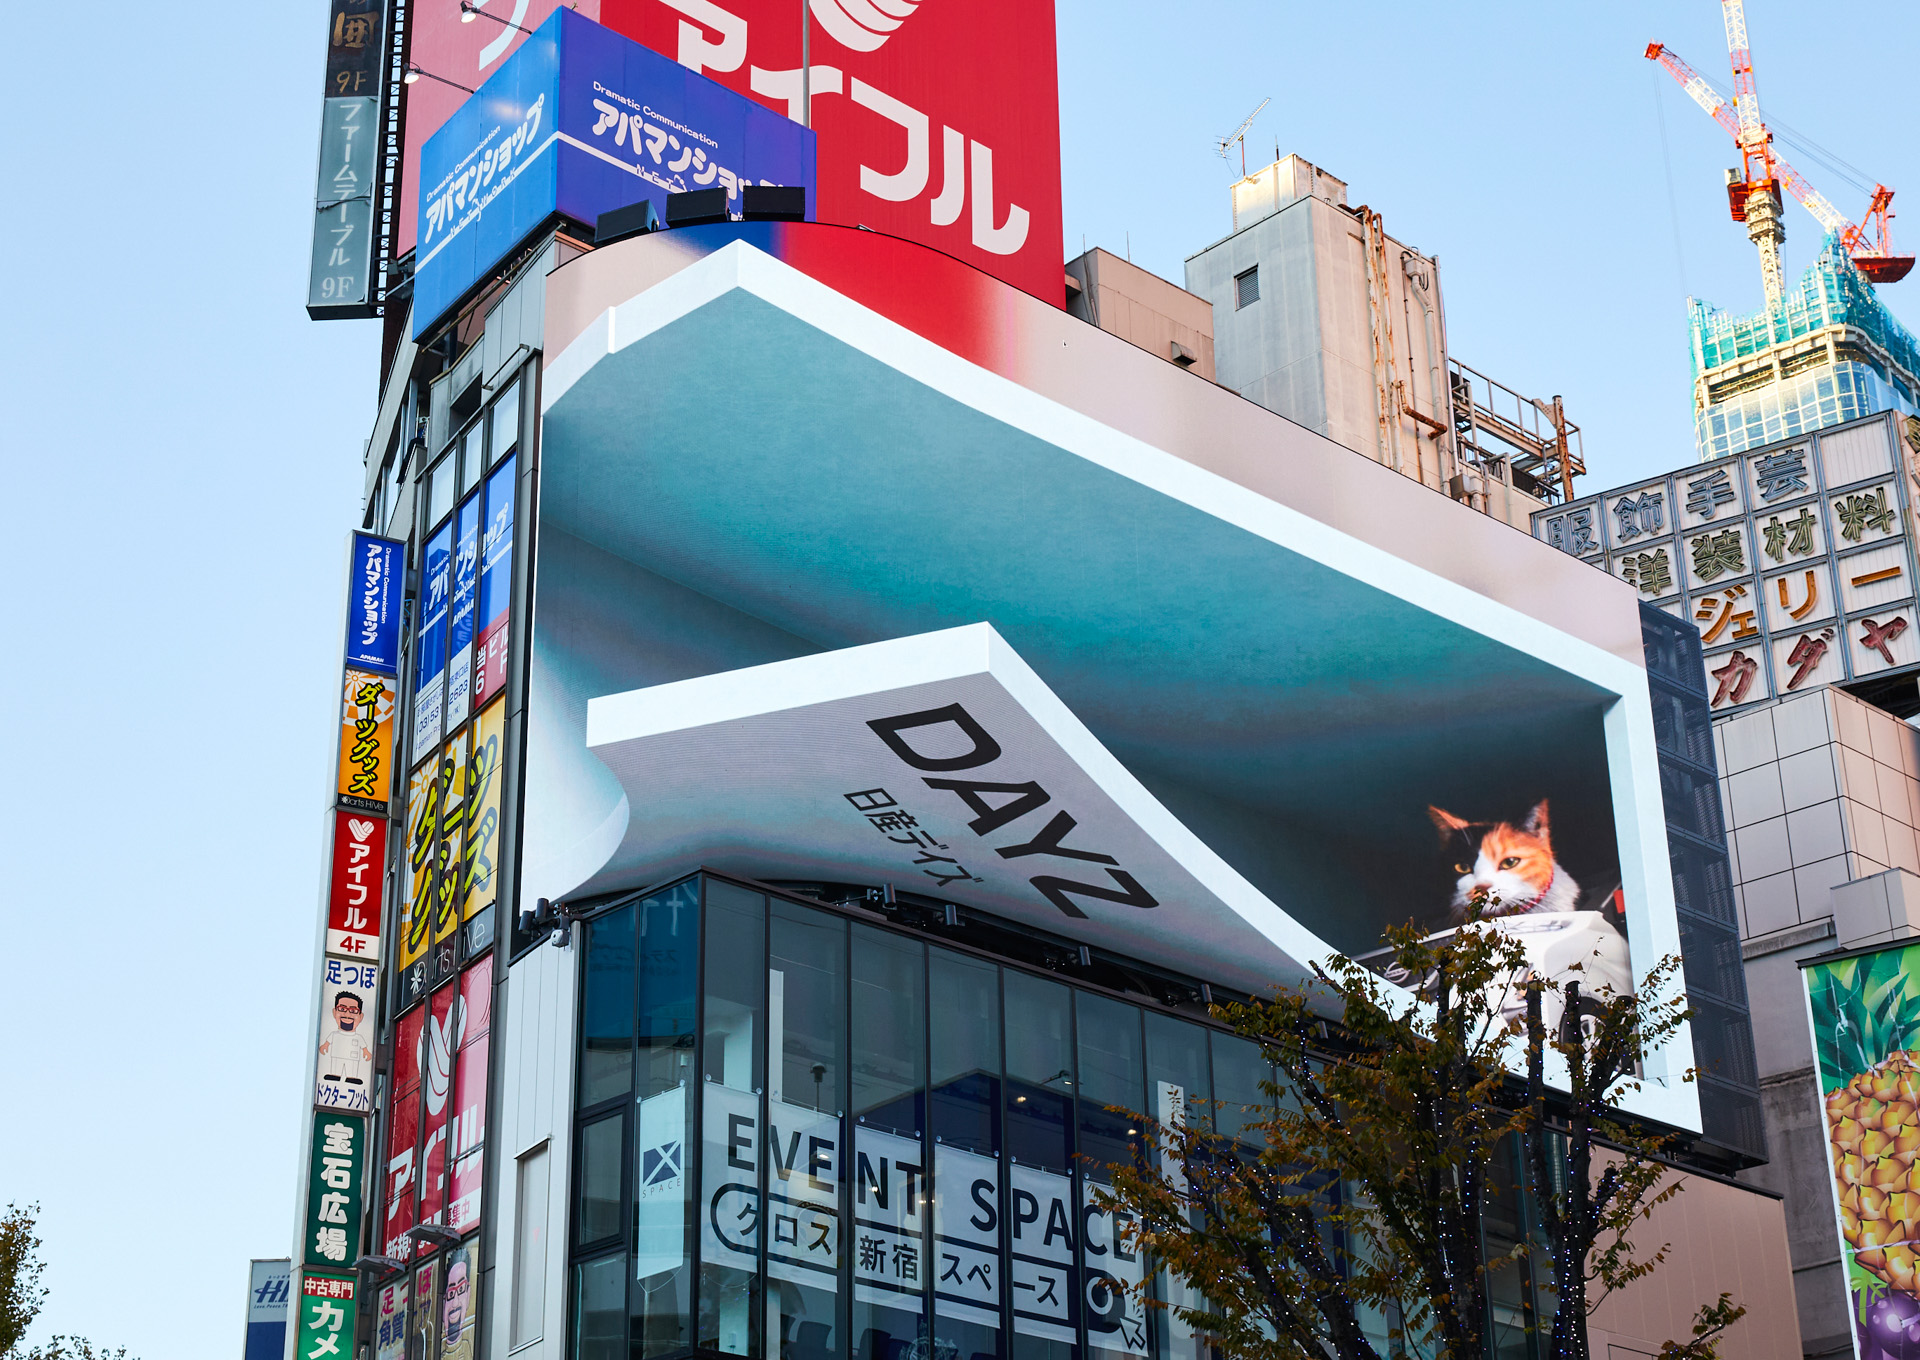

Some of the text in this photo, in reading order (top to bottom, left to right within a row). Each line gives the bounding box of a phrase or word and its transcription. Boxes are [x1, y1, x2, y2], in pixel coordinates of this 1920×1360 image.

[336, 70, 368, 93] 9F
[593, 80, 719, 149] Dramatic Communication
[328, 103, 362, 266] ファームテーブル
[424, 92, 545, 244] アパマンショップ
[426, 125, 501, 203] Dramatic Communication
[321, 276, 354, 299] 9F
[1547, 448, 1809, 556] 服飾手芸
[1621, 486, 1896, 595] 洋装材料
[361, 543, 383, 645] アパマンショップ
[381, 547, 392, 624] Dramatic Communication
[360, 653, 385, 663] APAMAN
[475, 648, 508, 696] 6F
[1710, 615, 1908, 708] カダヤ
[350, 682, 385, 796] ダーツグッズ
[843, 788, 984, 887] 日産デイズ
[865, 702, 1160, 919] DAYZ
[344, 842, 370, 930] アイフル
[325, 960, 376, 989] 足つぼ
[340, 935, 366, 954] 4F
[316, 1083, 369, 1110] ドクターフット
[315, 1122, 354, 1262] 宝石広場
[642, 1177, 682, 1199] SPACE
[728, 1112, 1137, 1263] EVENT SPACE
[304, 1277, 354, 1299] 中古専門
[307, 1301, 345, 1360] カメ
